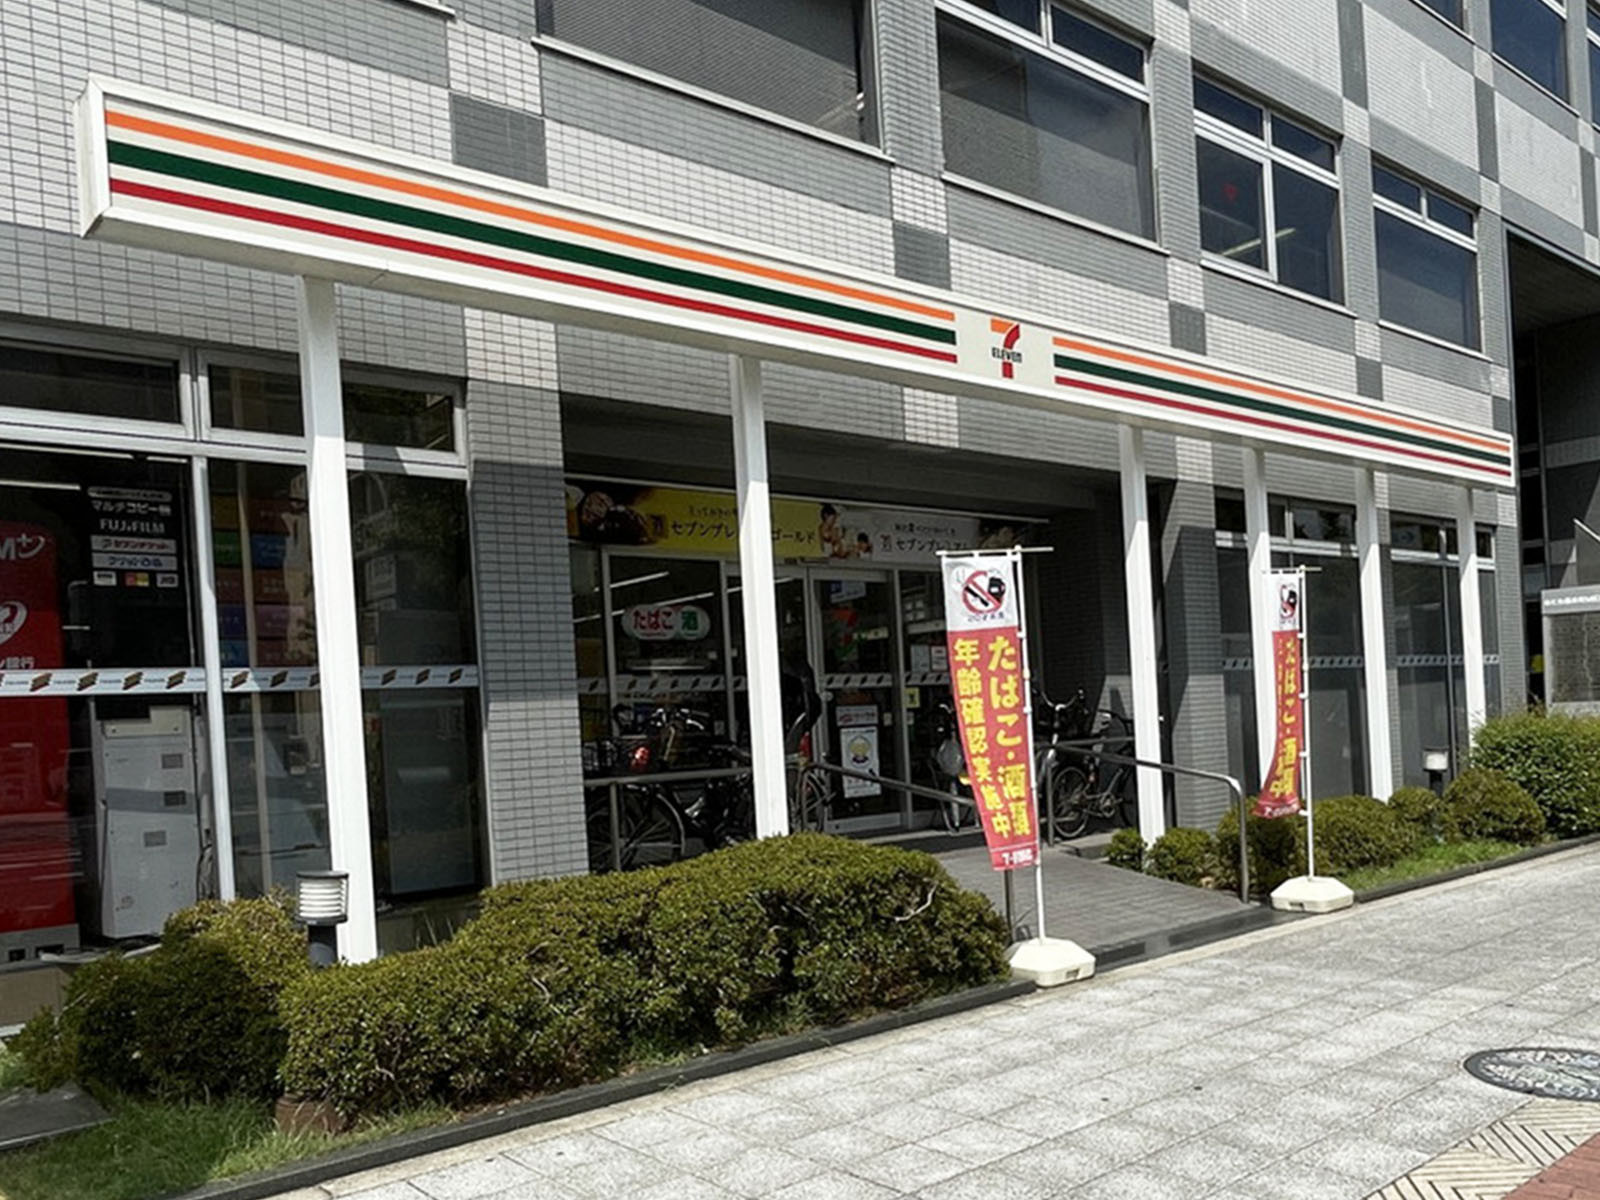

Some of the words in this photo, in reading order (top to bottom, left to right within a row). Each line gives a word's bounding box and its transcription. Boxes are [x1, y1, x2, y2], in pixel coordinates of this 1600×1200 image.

[633, 609, 675, 630] たばこ
[681, 611, 699, 630] 酒
[953, 637, 1013, 839] 年齢確認実施中
